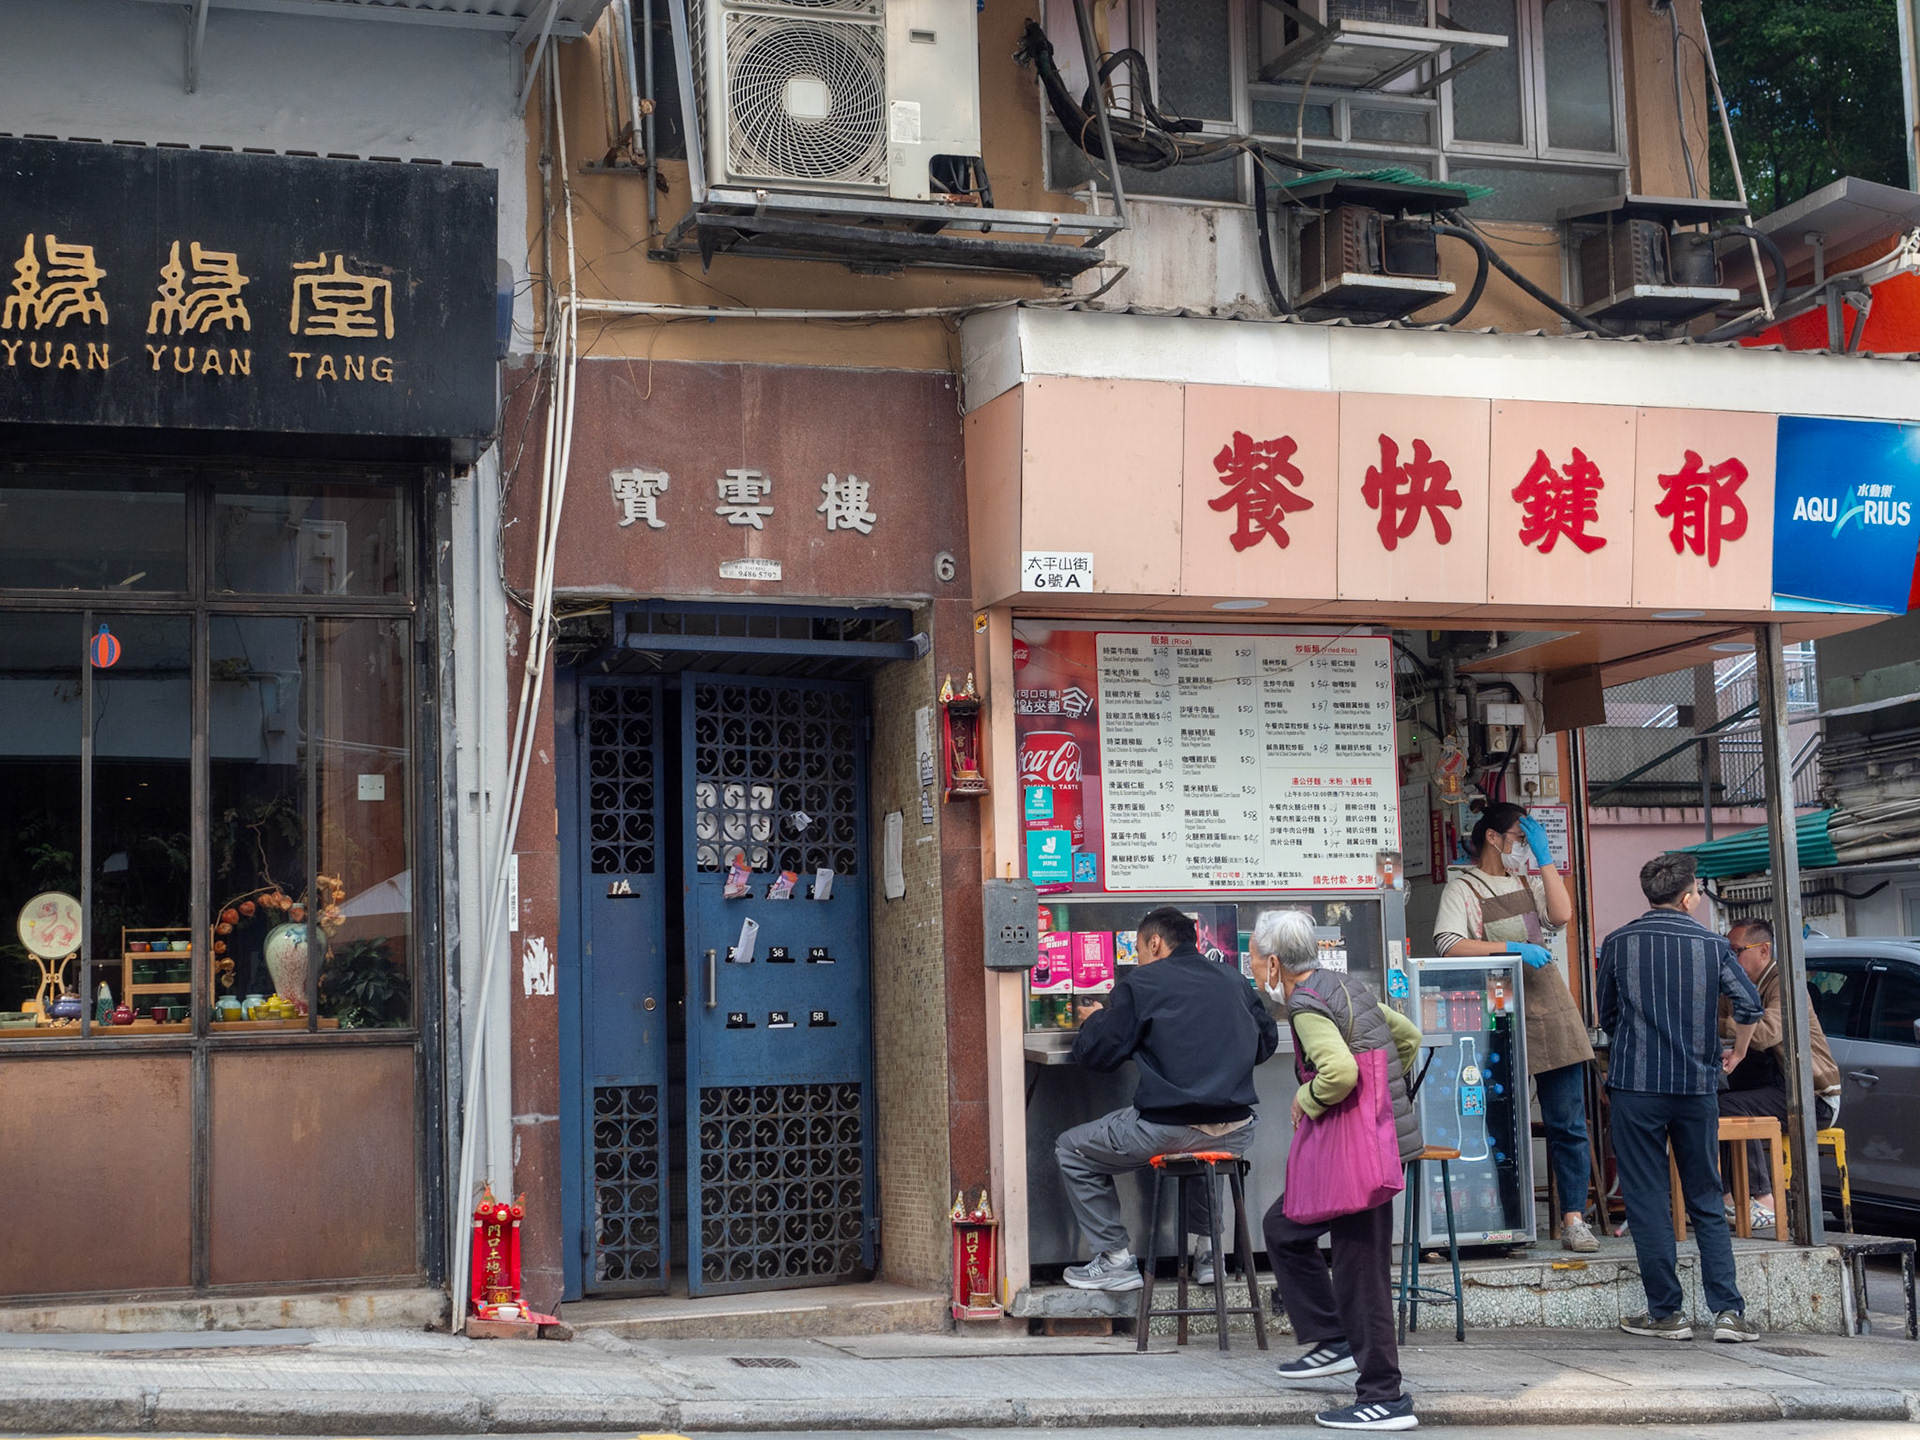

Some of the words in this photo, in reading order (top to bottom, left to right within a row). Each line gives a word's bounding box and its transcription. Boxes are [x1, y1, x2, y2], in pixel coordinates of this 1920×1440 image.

[1, 340, 109, 369] YUAN
[145, 344, 251, 375] YUAN
[289, 352, 394, 382] TANG
[612, 468, 876, 535] 寶雲樓
[1793, 485, 1911, 538] AQUARIUS
[937, 556, 954, 582] 6
[1027, 556, 1089, 572] 太平山街
[1034, 573, 1081, 588] 6號A
[1171, 638, 1193, 646] (Rice)
[772, 948, 784, 957] 3B
[772, 1012, 784, 1022] 5A
[812, 1012, 824, 1021] 5B
